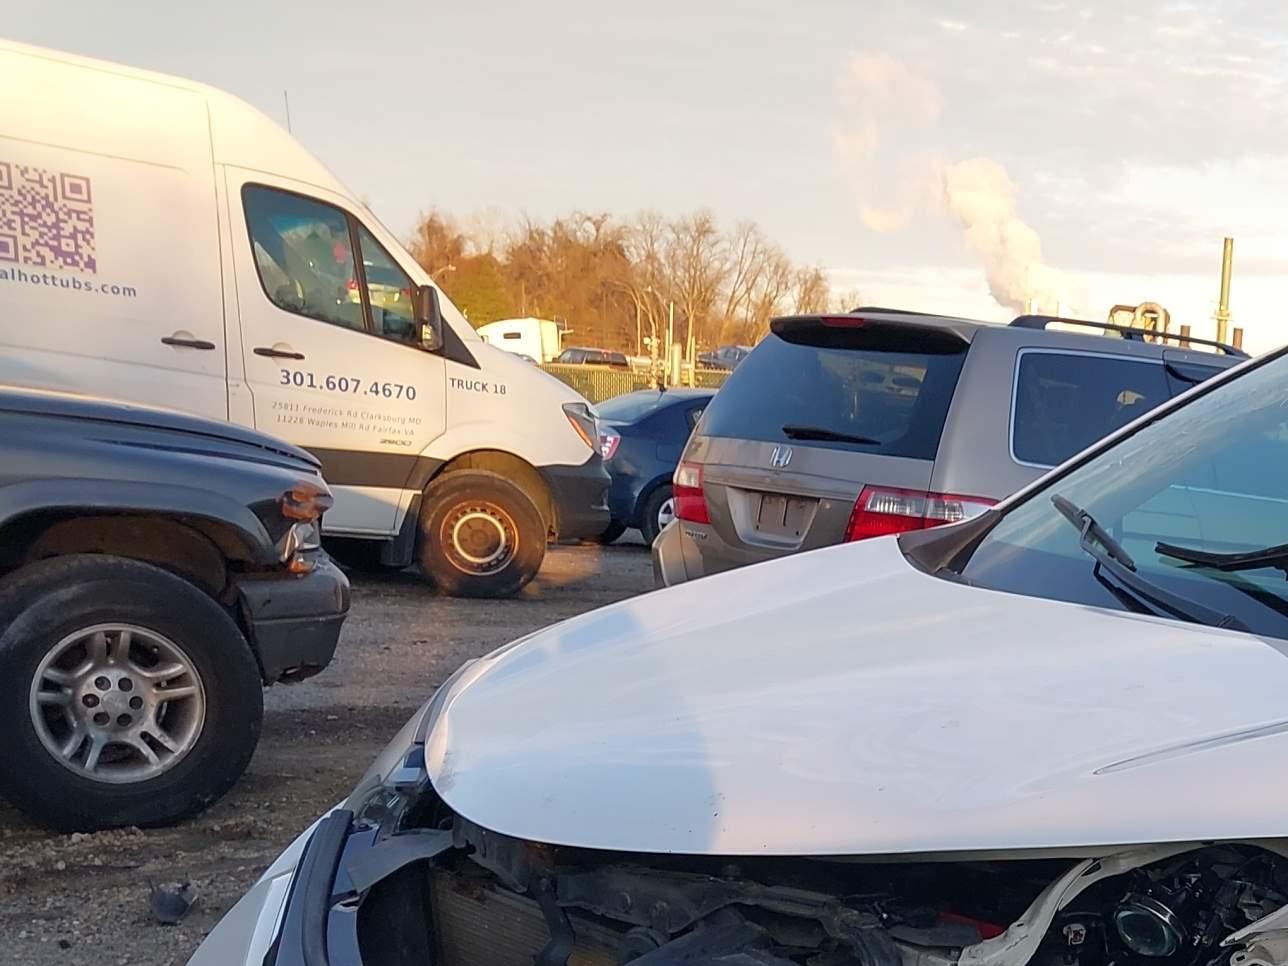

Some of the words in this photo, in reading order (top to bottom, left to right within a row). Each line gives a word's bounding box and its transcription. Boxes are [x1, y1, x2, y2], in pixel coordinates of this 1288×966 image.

[279, 369, 417, 401] 301.607.4670
[449, 377, 489, 393] TRUCK
[493, 383, 506, 395] 18
